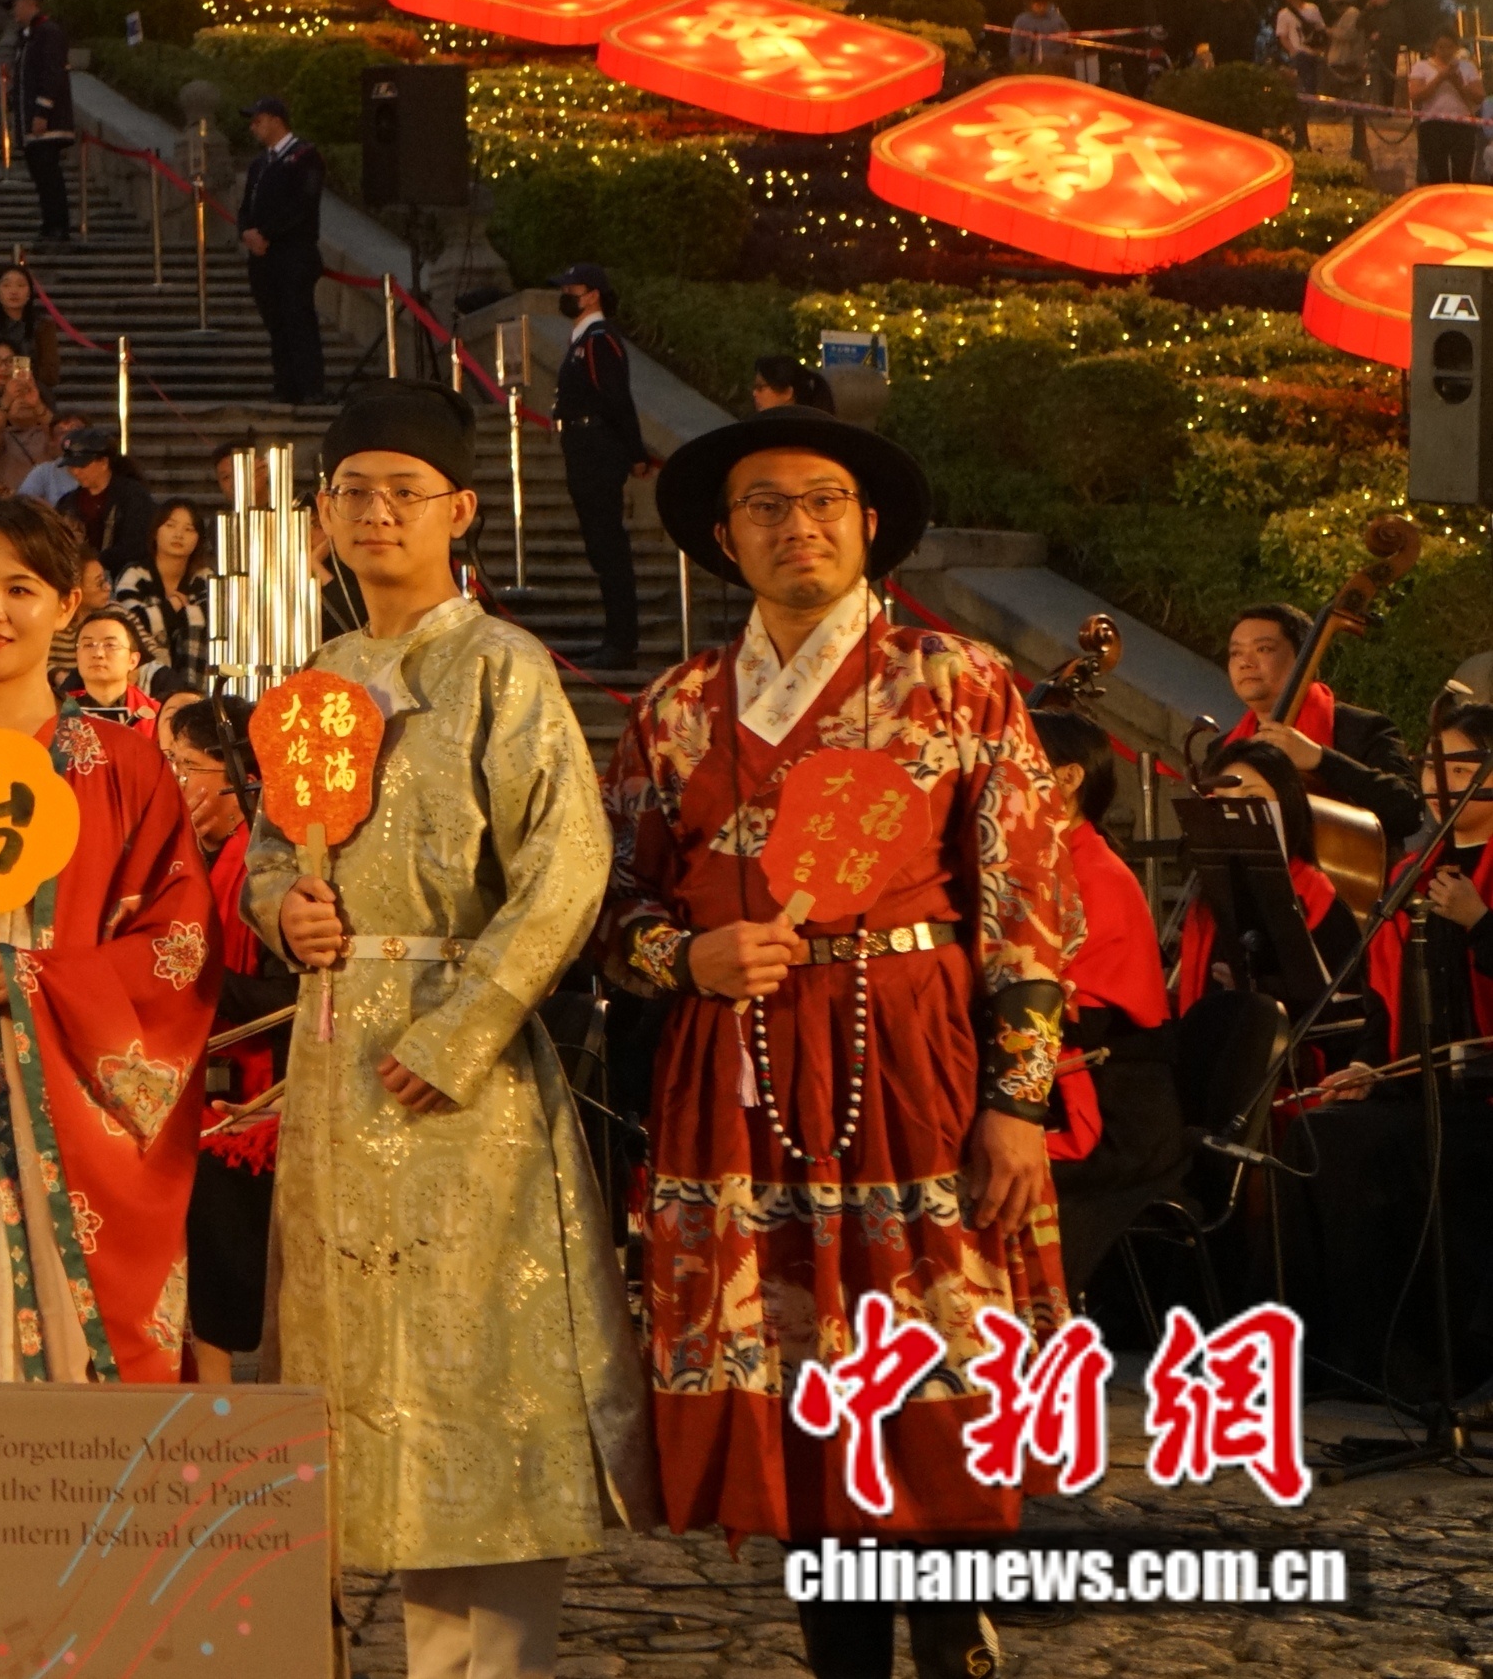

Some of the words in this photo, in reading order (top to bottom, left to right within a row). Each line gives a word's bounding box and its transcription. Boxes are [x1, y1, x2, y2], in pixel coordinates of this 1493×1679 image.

[951, 103, 1188, 206] 新
[1431, 294, 1479, 320] LA
[280, 693, 313, 808] 大炮台
[319, 691, 357, 793] 福滿
[142, 1436, 260, 1465] Melodies
[266, 1442, 291, 1465] at
[1, 1478, 41, 1503] the
[50, 1478, 125, 1505] Ruins
[133, 1479, 158, 1505] of
[166, 1480, 201, 1506] St.
[80, 1521, 180, 1550] Festival
[187, 1523, 292, 1551] Concert
